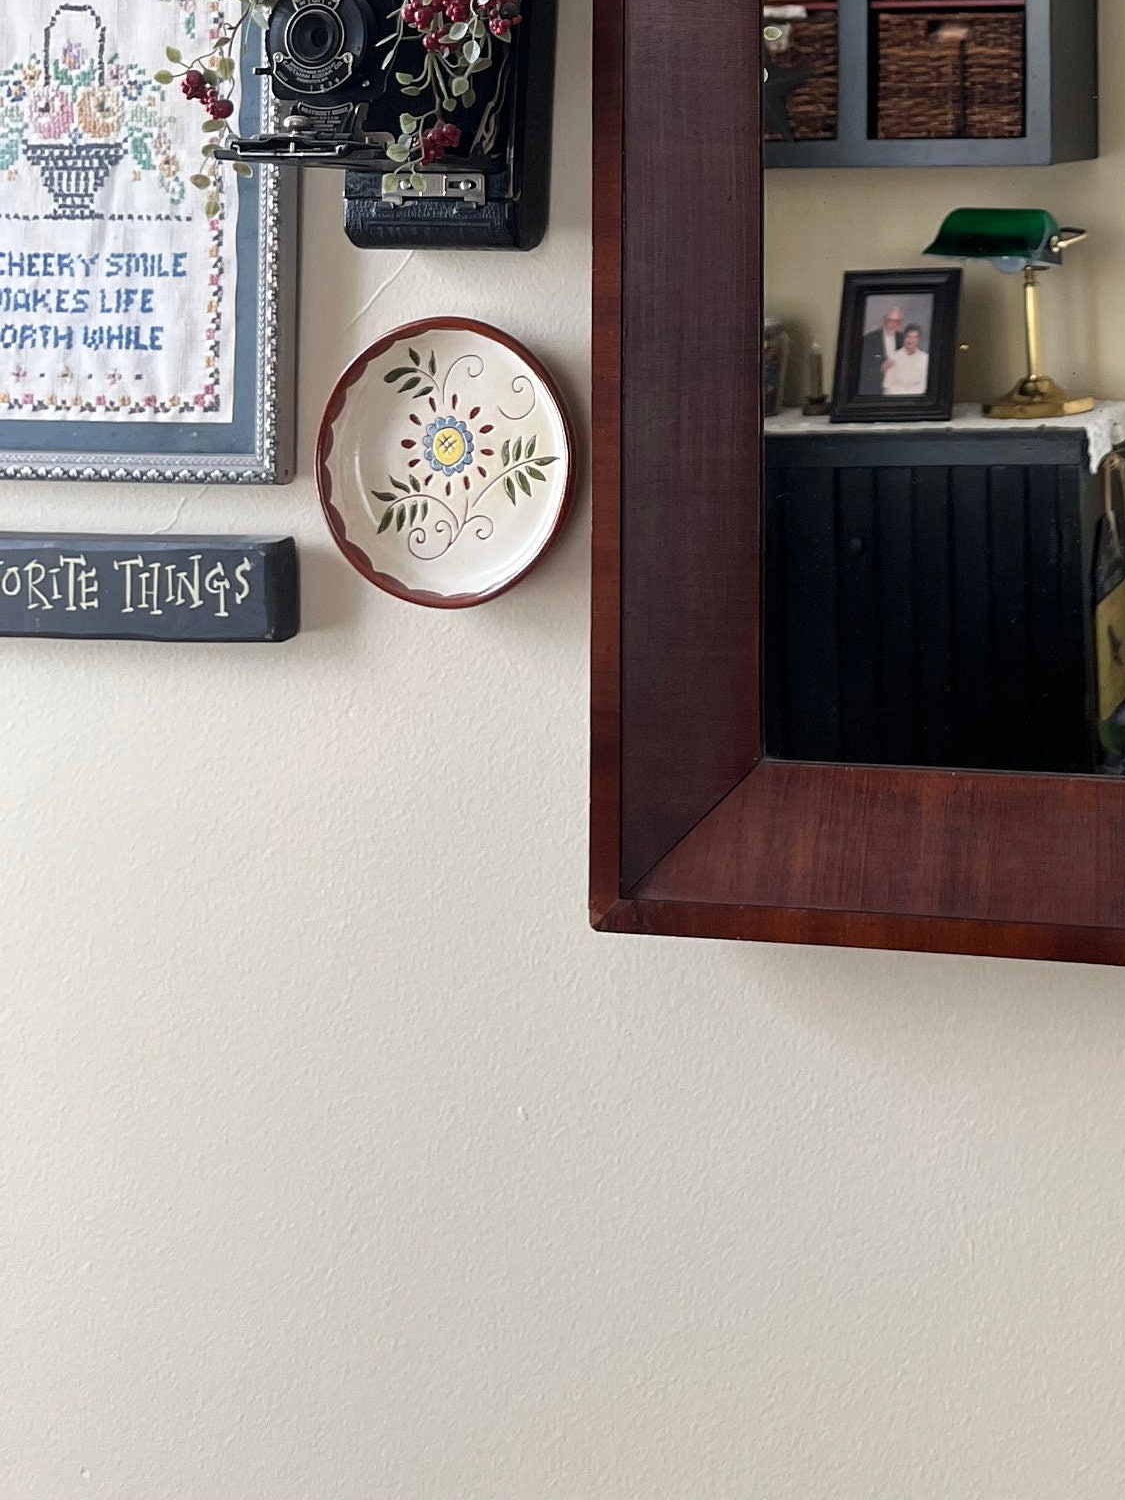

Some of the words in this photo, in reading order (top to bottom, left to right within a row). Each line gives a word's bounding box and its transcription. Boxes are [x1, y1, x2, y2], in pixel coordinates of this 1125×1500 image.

[106, 251, 187, 277] SMILE
[100, 288, 154, 313] LIFE
[83, 323, 164, 350] WHILE
[0, 554, 98, 610] ORITE
[113, 554, 252, 617] THINGS
